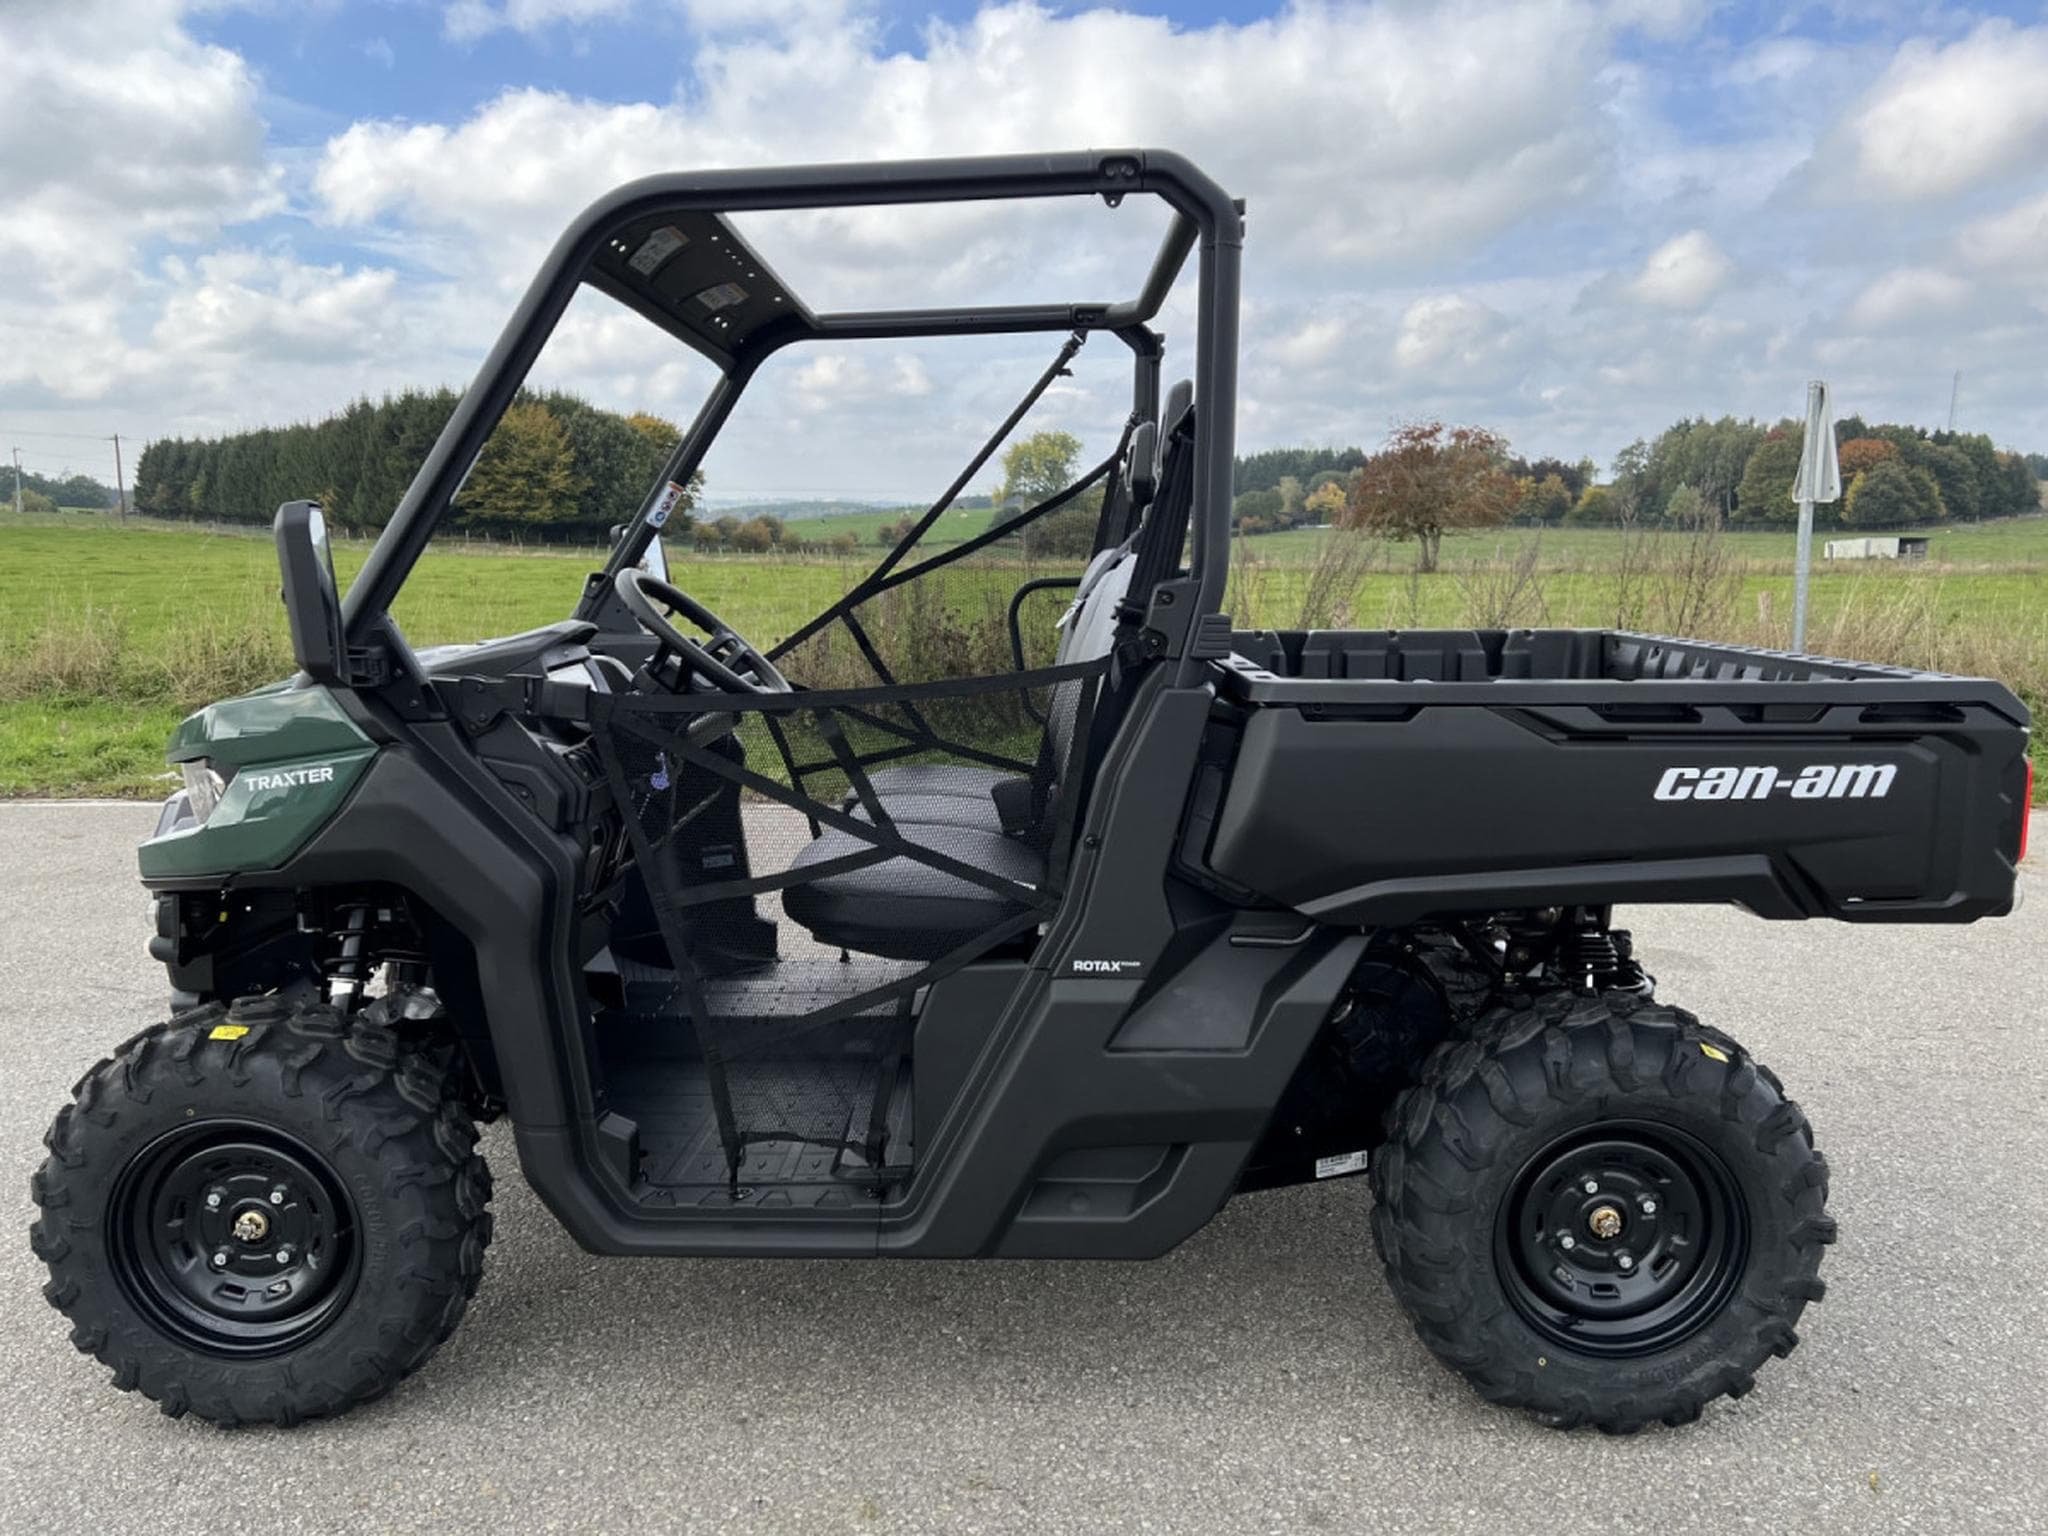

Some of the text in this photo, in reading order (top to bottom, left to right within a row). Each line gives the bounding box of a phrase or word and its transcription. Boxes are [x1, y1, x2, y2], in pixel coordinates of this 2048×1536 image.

[245, 767, 334, 792] TRAXTER
[1653, 763, 1898, 801] can-am
[1073, 960, 1121, 972] ROTAX
